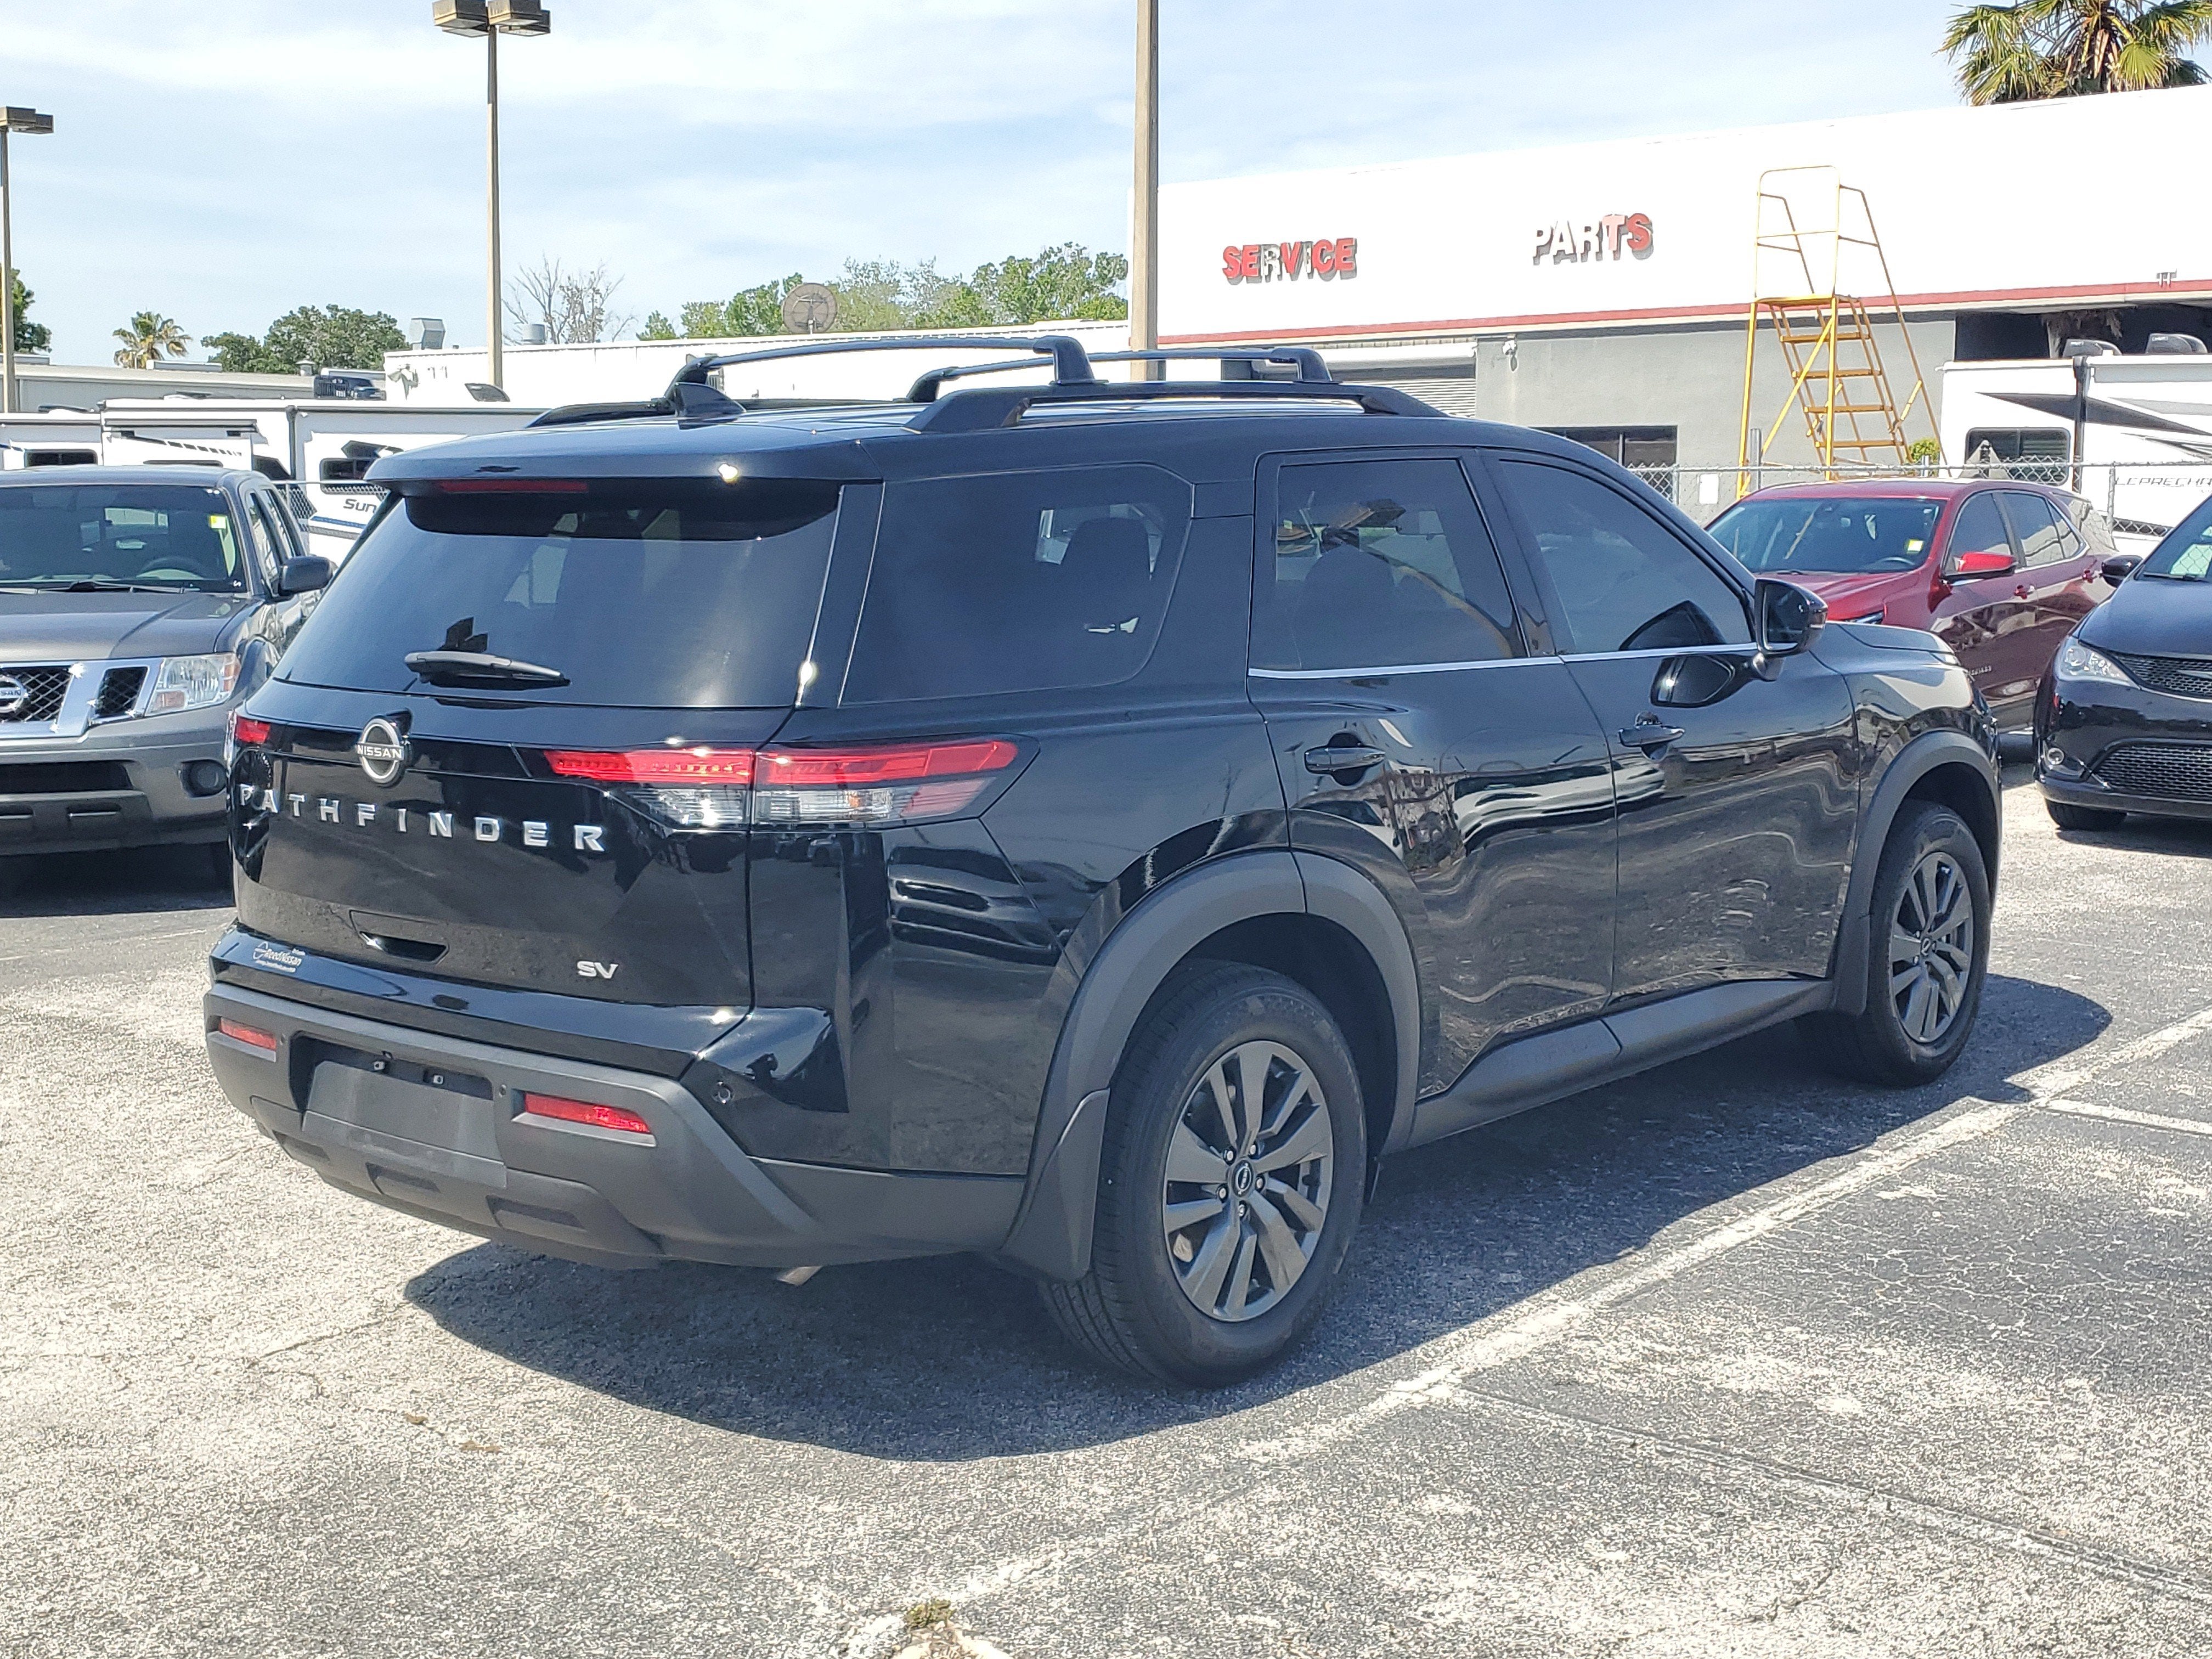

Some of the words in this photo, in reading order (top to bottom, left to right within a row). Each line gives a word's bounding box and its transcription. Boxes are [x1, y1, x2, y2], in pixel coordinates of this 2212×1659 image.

[1533, 213, 1653, 263] PARTS
[1222, 238, 1357, 283] SERVICE
[343, 499, 377, 513] Sun
[357, 744, 402, 758] NISSAN
[240, 785, 605, 851] PATHFINDER
[577, 961, 619, 979] SV
